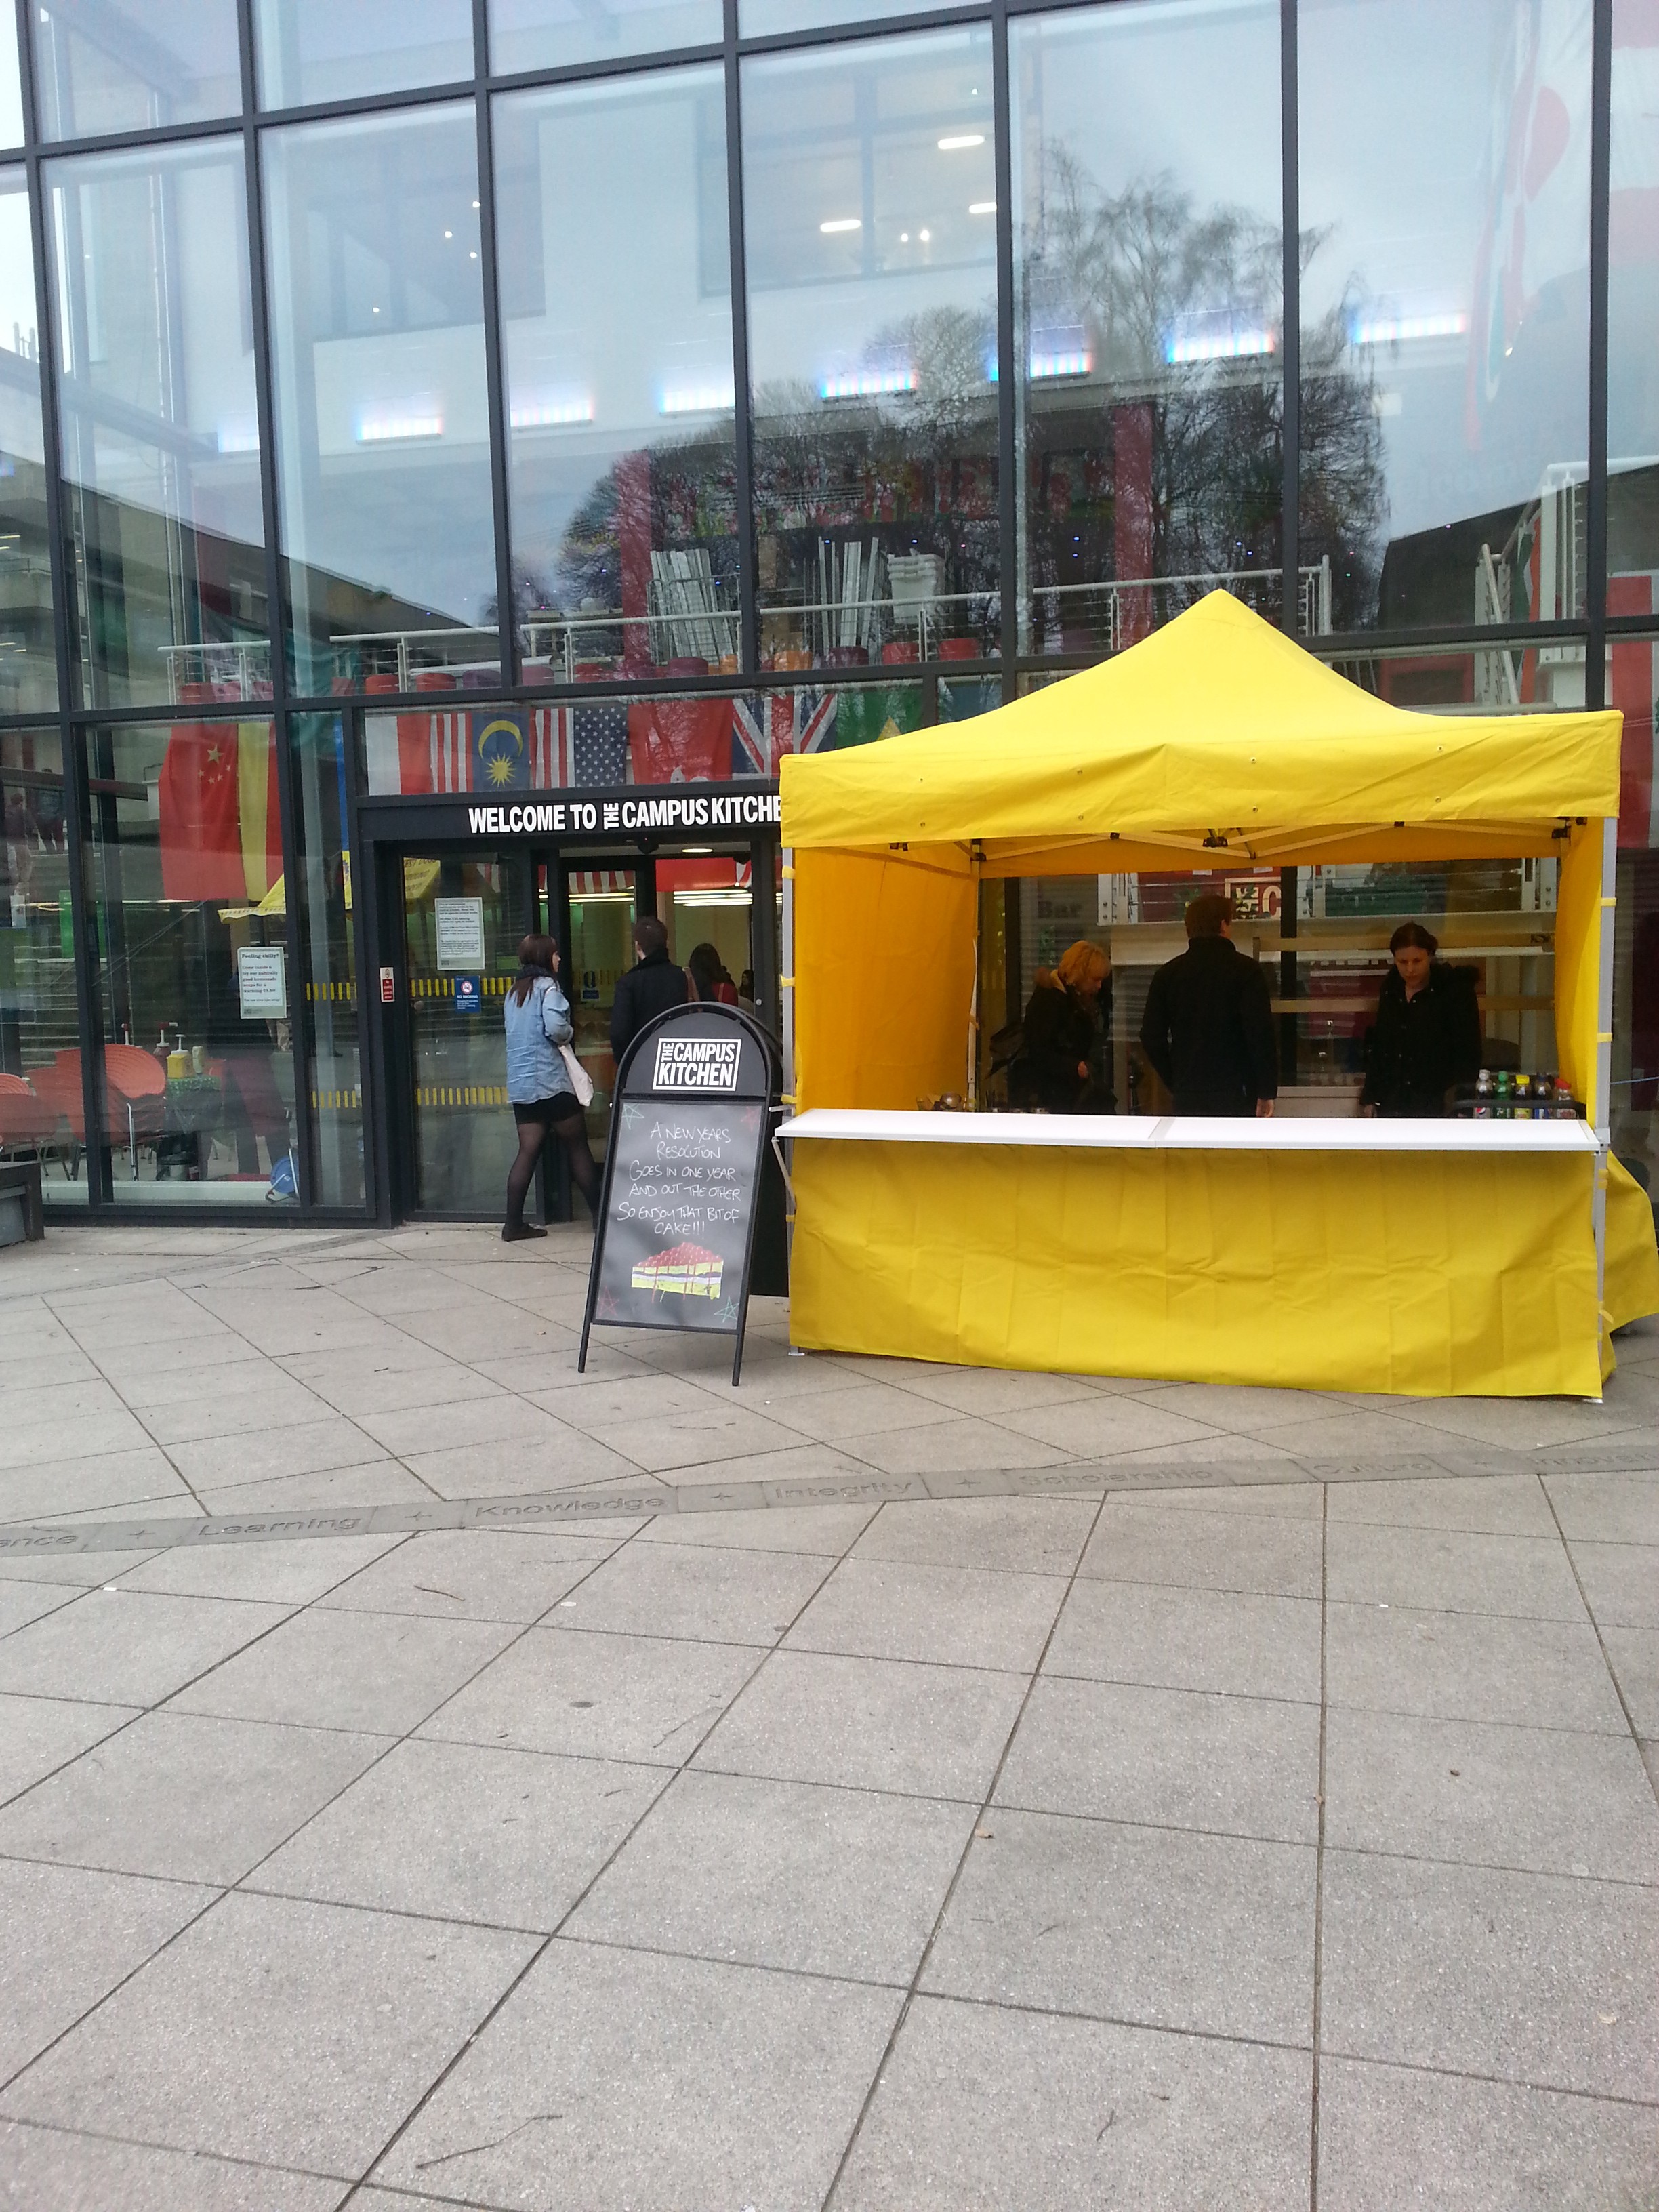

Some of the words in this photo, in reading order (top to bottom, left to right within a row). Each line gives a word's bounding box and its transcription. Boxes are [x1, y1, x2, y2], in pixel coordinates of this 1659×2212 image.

[468, 804, 566, 834] WELCOME
[569, 803, 597, 830] TO
[603, 802, 619, 830] THE
[622, 798, 710, 828] CAMPUS
[661, 1042, 674, 1062] THE
[674, 1042, 735, 1062] CAMPUS
[658, 1063, 733, 1086] KITCHEN
[650, 1122, 661, 1139] A
[665, 1123, 696, 1139] NEW
[697, 1126, 731, 1144] YEARS
[657, 1141, 720, 1160] RESOLUTION
[629, 1160, 662, 1181] GOES
[666, 1166, 677, 1177] IN
[682, 1166, 703, 1178] ONE
[706, 1167, 736, 1182] YEAR
[629, 1183, 657, 1197] AND
[661, 1183, 683, 1194] OUT
[683, 1184, 707, 1197] THE
[708, 1186, 741, 1201] OTHER
[617, 1202, 636, 1221] SO
[638, 1206, 675, 1221] ENJOY
[676, 1205, 704, 1218] THAT
[707, 1207, 724, 1221] BIT
[724, 1208, 739, 1223] OF
[654, 1221, 705, 1235] CAKE!!!
[199, 1516, 362, 1536] Learning
[475, 1496, 665, 1517] Knowledge
[775, 1481, 912, 1500] Integrity
